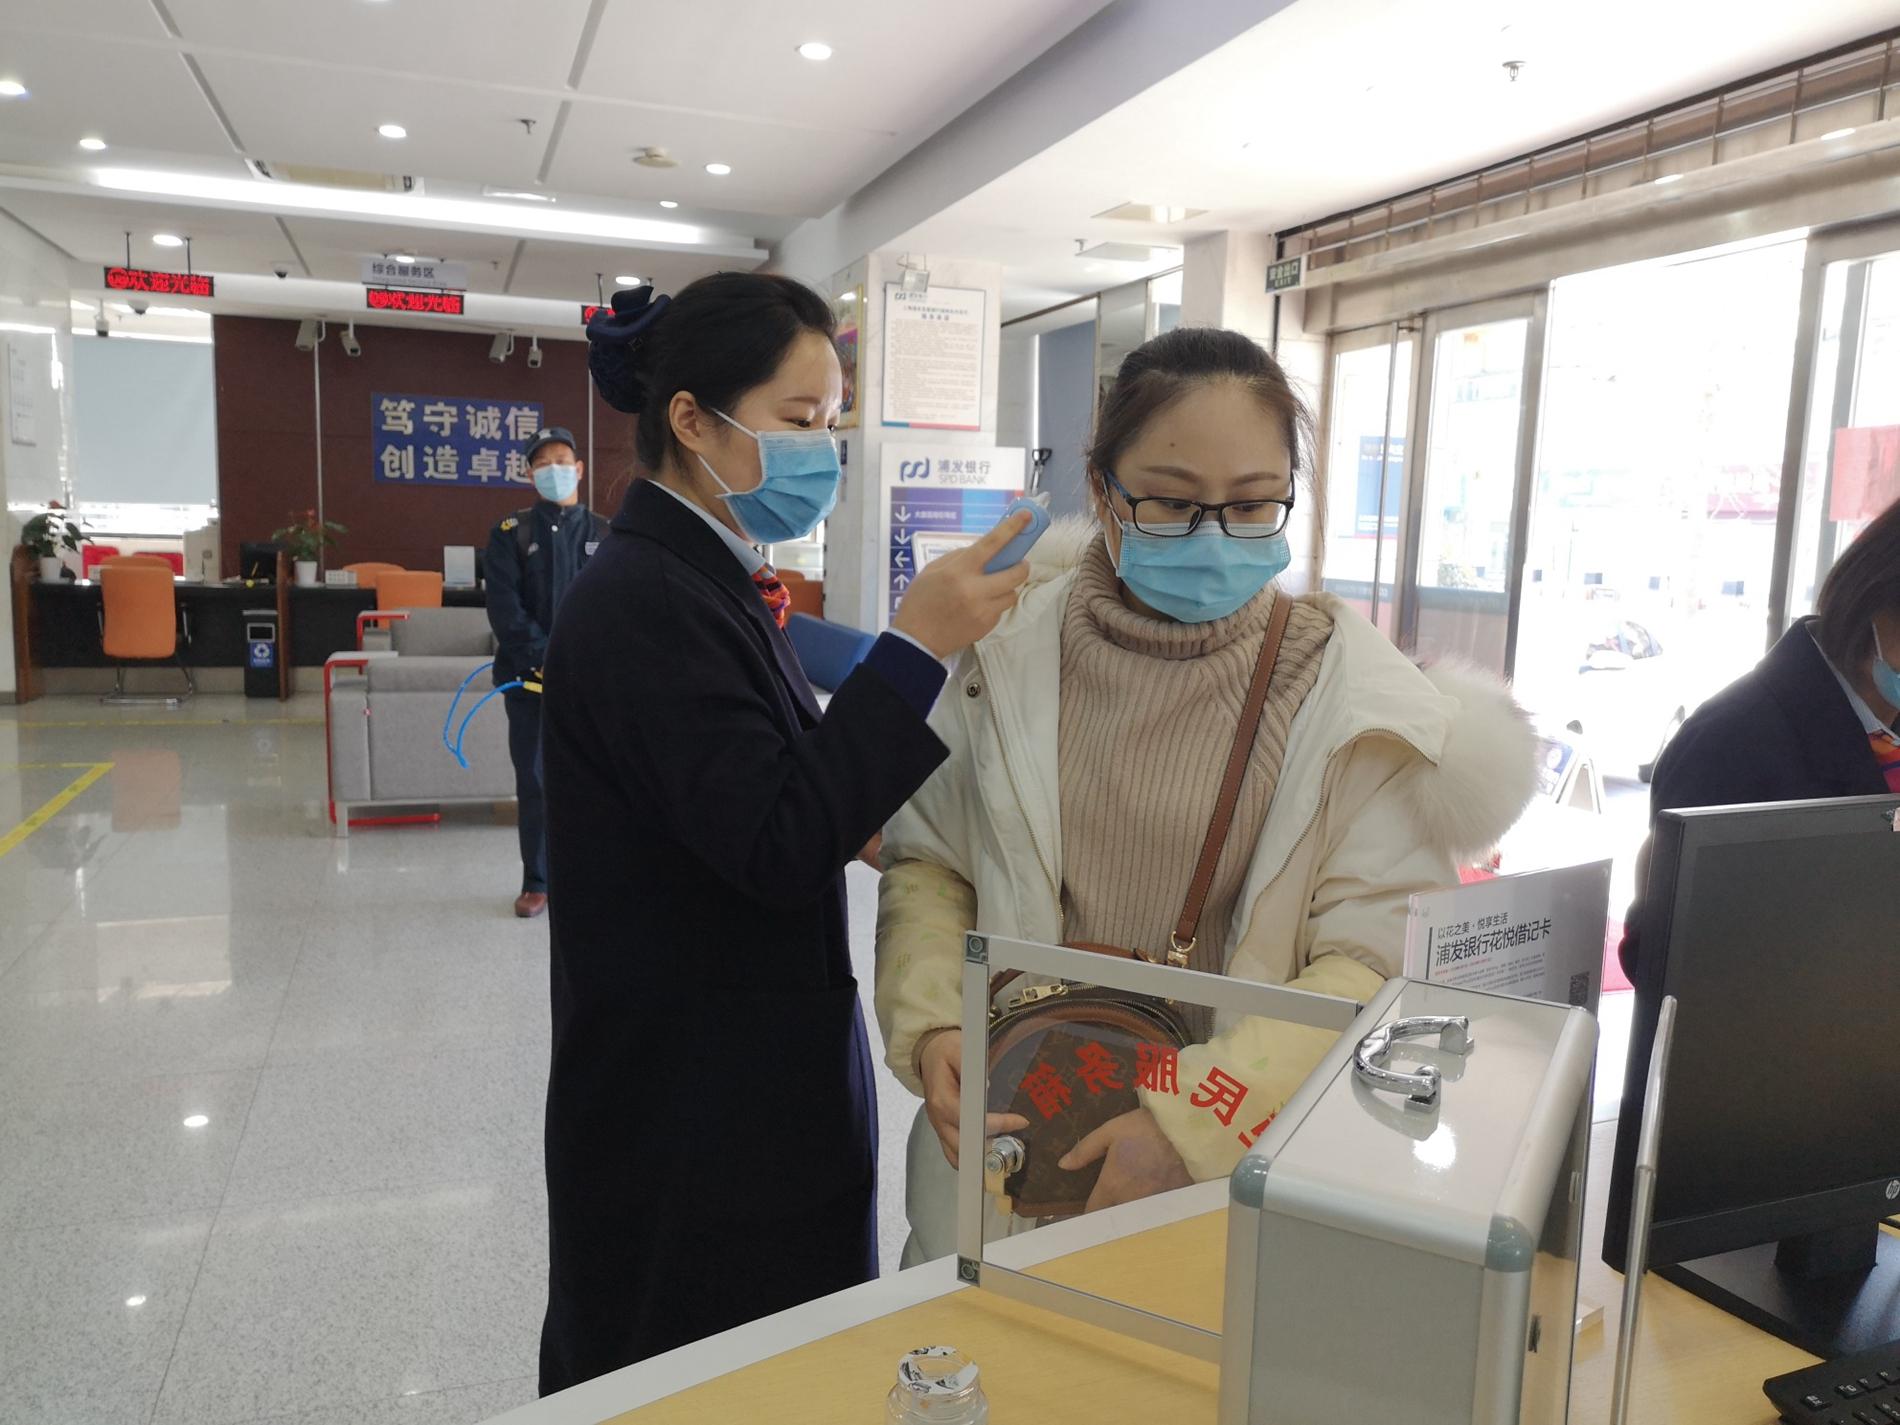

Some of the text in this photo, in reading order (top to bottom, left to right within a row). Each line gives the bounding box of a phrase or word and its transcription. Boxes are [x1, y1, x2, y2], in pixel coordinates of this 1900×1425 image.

[372, 263, 435, 279] 综合服务区
[380, 398, 539, 440] 笃守诚信
[938, 459, 991, 475] 浦发银行
[939, 474, 986, 485] SPD BANK
[1438, 912, 1508, 938] 以花之美·悦享生活
[1436, 917, 1552, 966] 浦发银行花悦借记卡
